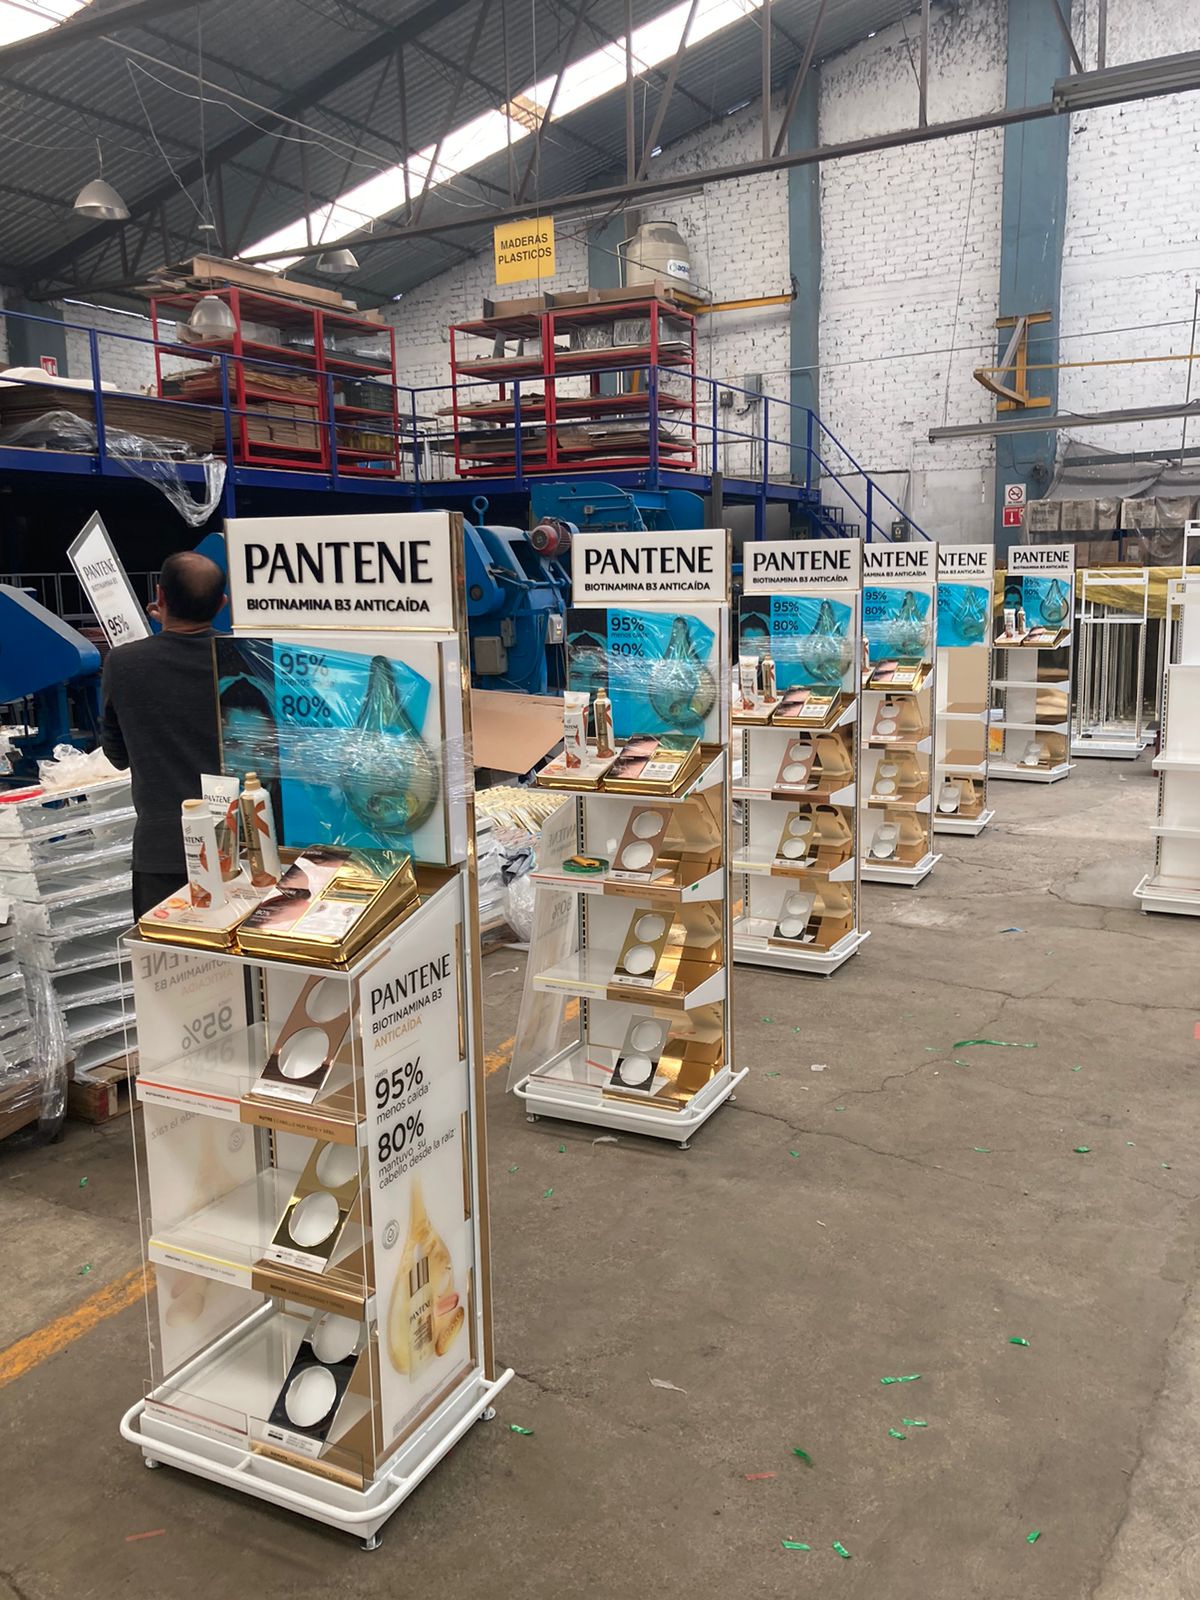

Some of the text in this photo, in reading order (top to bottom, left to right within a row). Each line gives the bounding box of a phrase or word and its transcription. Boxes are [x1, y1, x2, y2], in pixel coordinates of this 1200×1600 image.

[500, 233, 548, 250] MADERAS
[498, 247, 552, 264] PLASTICOS
[244, 541, 433, 583] PANTENE
[585, 546, 713, 574] PANTENE
[753, 550, 851, 571] PANTENE
[863, 551, 929, 567] ANTENE
[939, 553, 987, 566] NTENE
[1013, 551, 1069, 563] PANTENE
[82, 558, 117, 580] PANTENE
[584, 580, 711, 591] BIOTINAMINA B3 ANTICAÍDA
[753, 576, 798, 584] BIOTINAMINA
[809, 574, 848, 582] ANTICAÍDA
[865, 592, 887, 600] 95%
[938, 586, 952, 594] 5%
[247, 597, 430, 612] BIOTINAMINA B3 ANTICAÍDA
[773, 600, 800, 612] 95%
[865, 606, 886, 615] 80%
[938, 599, 951, 607] 0%
[107, 614, 131, 636] 95%
[611, 616, 645, 631] 95%
[773, 620, 799, 631] 80%
[611, 642, 645, 657] 80%
[279, 653, 329, 676] 95%
[281, 694, 331, 718] 80%
[203, 794, 232, 804] PANTENE
[371, 953, 451, 1015] PANTENE
[372, 987, 443, 1034] BIOTINAMINA B3
[374, 1016, 422, 1051] ANTICAÍDA
[376, 1056, 424, 1109] 95%
[377, 1099, 406, 1125] menos
[378, 1109, 424, 1162] 80%
[379, 1138, 427, 1177] mantuvo su
[379, 1162, 408, 1189] cabello
[409, 1144, 432, 1168] desde
[433, 1138, 441, 1150] la
